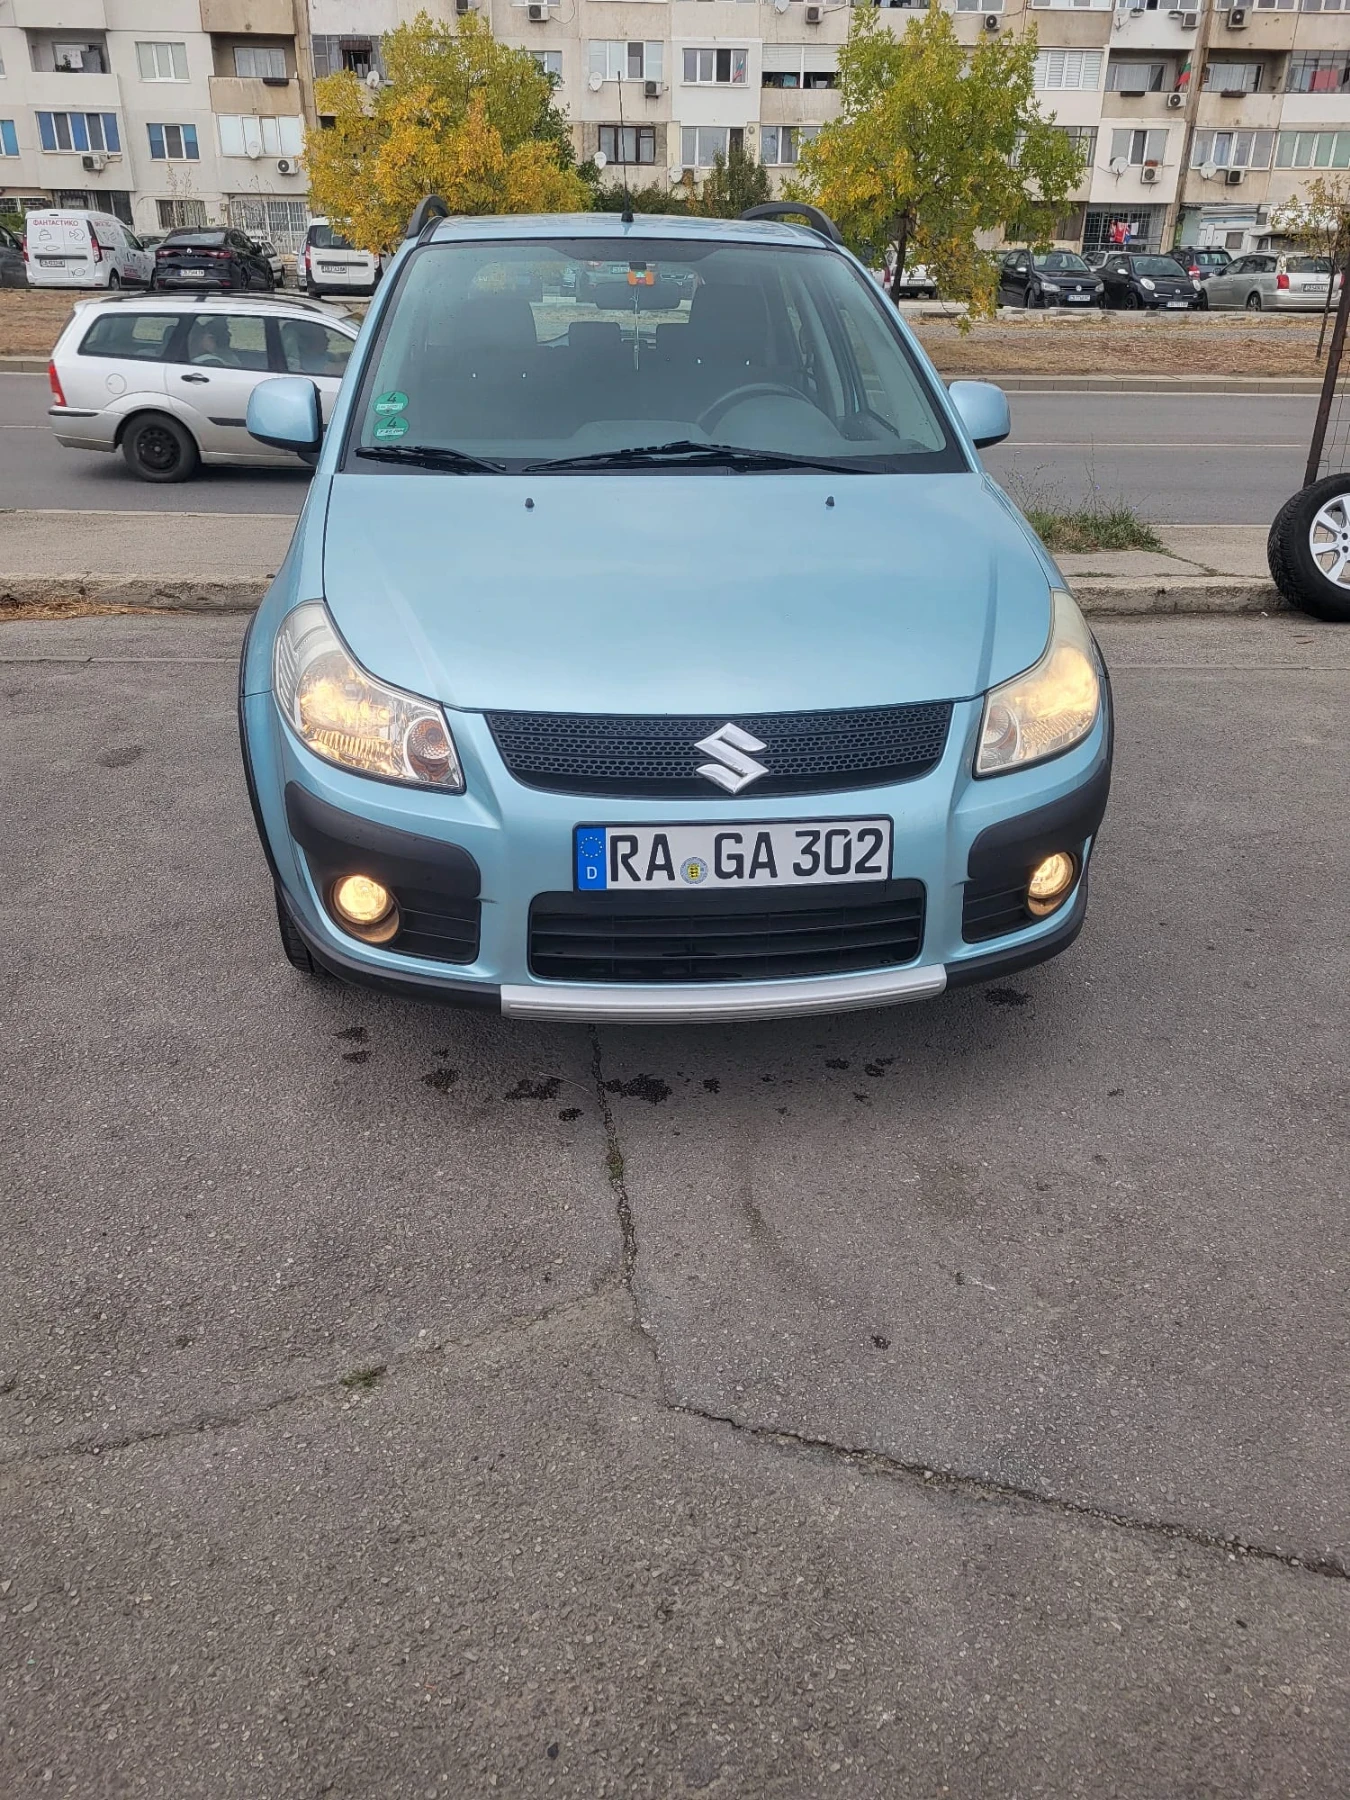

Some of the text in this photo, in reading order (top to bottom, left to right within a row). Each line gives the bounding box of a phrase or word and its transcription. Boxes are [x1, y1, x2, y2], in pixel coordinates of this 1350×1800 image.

[32, 219, 79, 227] ФАНТАСТИКО
[386, 392, 397, 403] 4
[386, 416, 397, 428] 4
[586, 827, 884, 882] D RA GA 302
